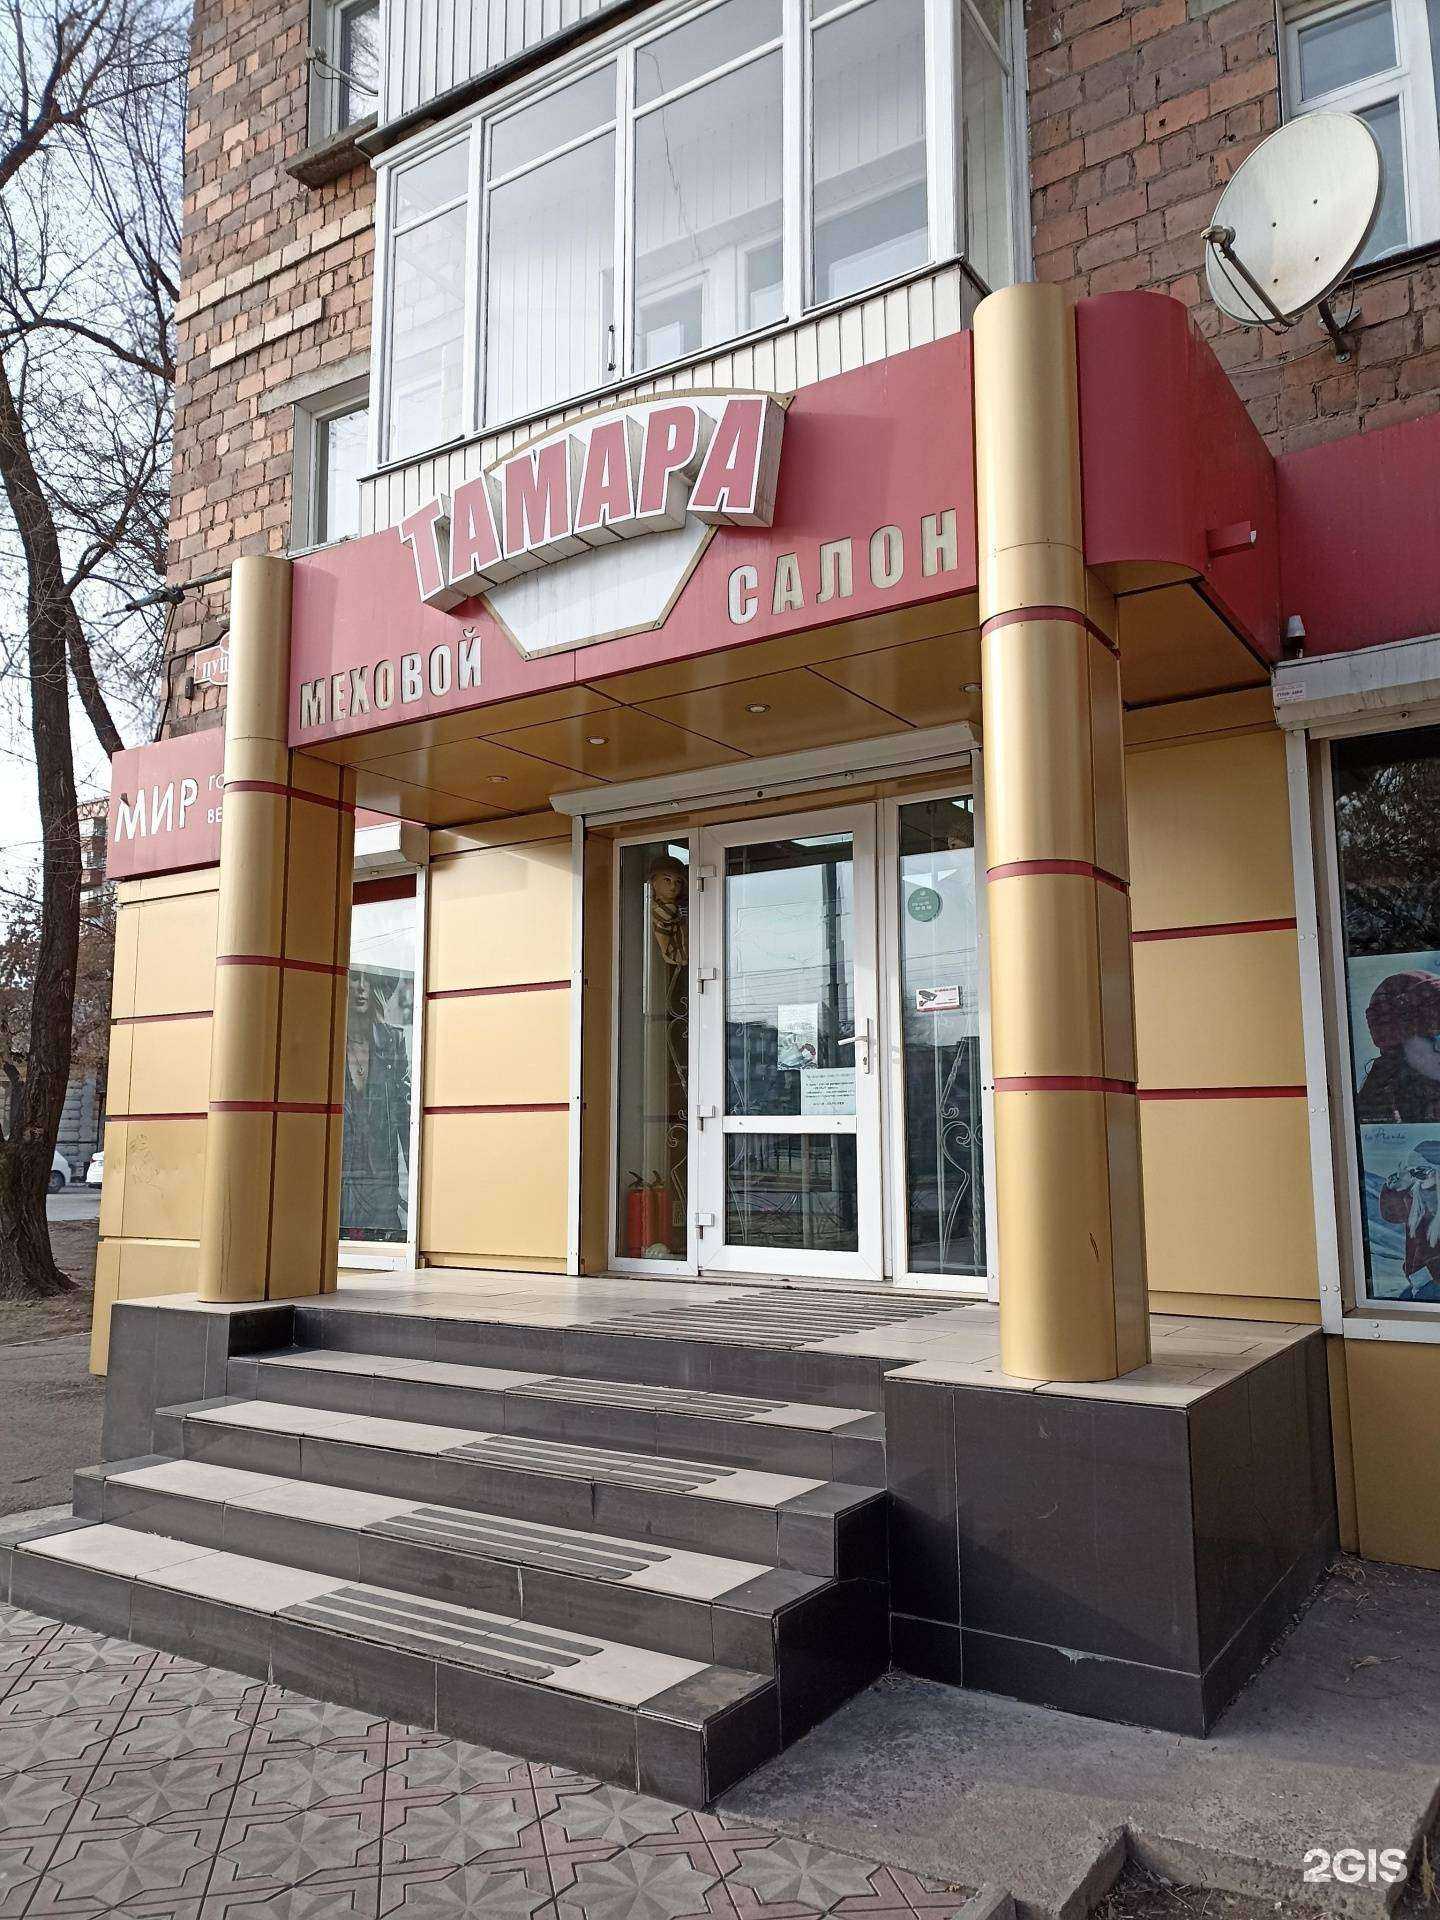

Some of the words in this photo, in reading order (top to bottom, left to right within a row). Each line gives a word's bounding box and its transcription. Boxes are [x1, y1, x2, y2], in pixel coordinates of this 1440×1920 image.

[399, 394, 770, 605] ТАМАРА
[727, 508, 958, 625] САЛОН
[300, 627, 482, 730] МЕХОВОЙ
[114, 778, 199, 843] МИР
